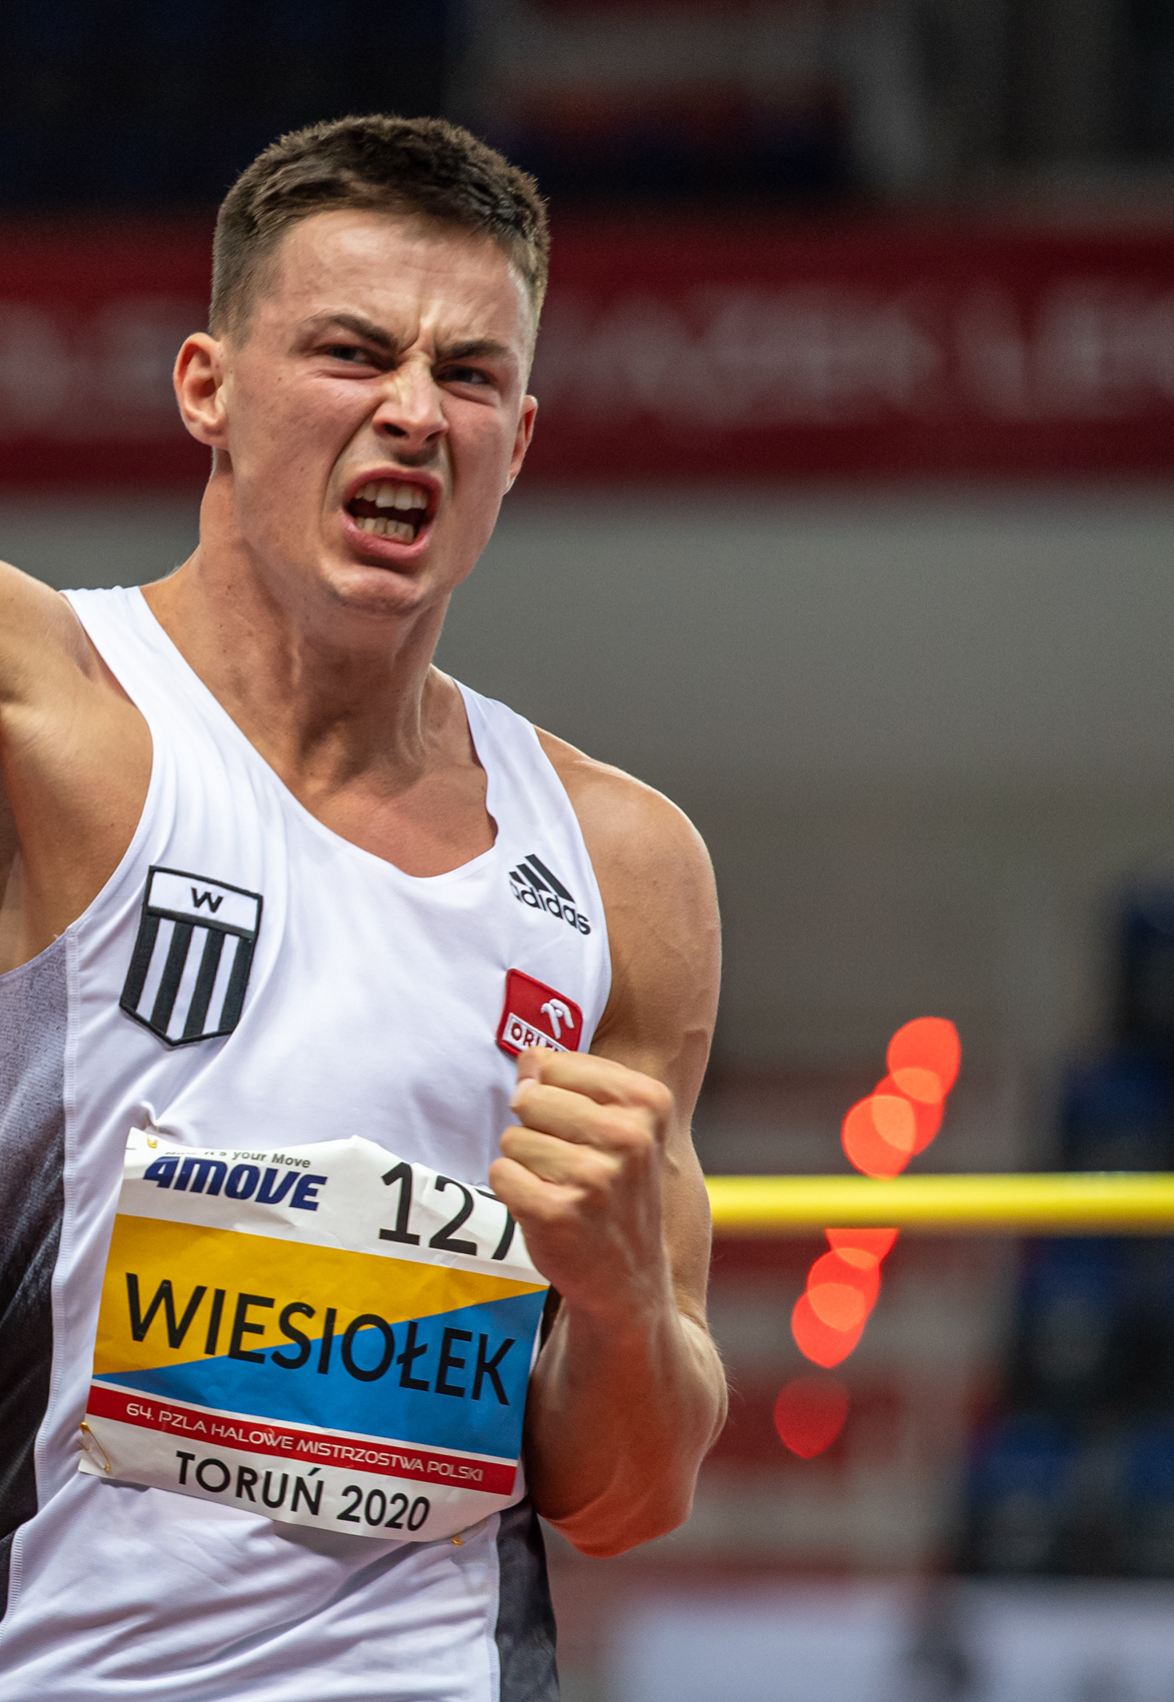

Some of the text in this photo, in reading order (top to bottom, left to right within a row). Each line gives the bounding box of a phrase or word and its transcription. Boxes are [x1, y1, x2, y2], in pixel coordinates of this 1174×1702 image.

[191, 887, 224, 914] W
[143, 1156, 328, 1211] 4MOVE
[232, 1151, 267, 1162] your
[271, 1153, 311, 1168] Move
[379, 1161, 518, 1261] 127
[125, 1272, 516, 1406] WIESIOŁEK
[126, 1403, 483, 1481] 64. PZLA HALOWE MISTRZOSTWA POLSKI
[176, 1450, 430, 1531] TORUŃ 2020
